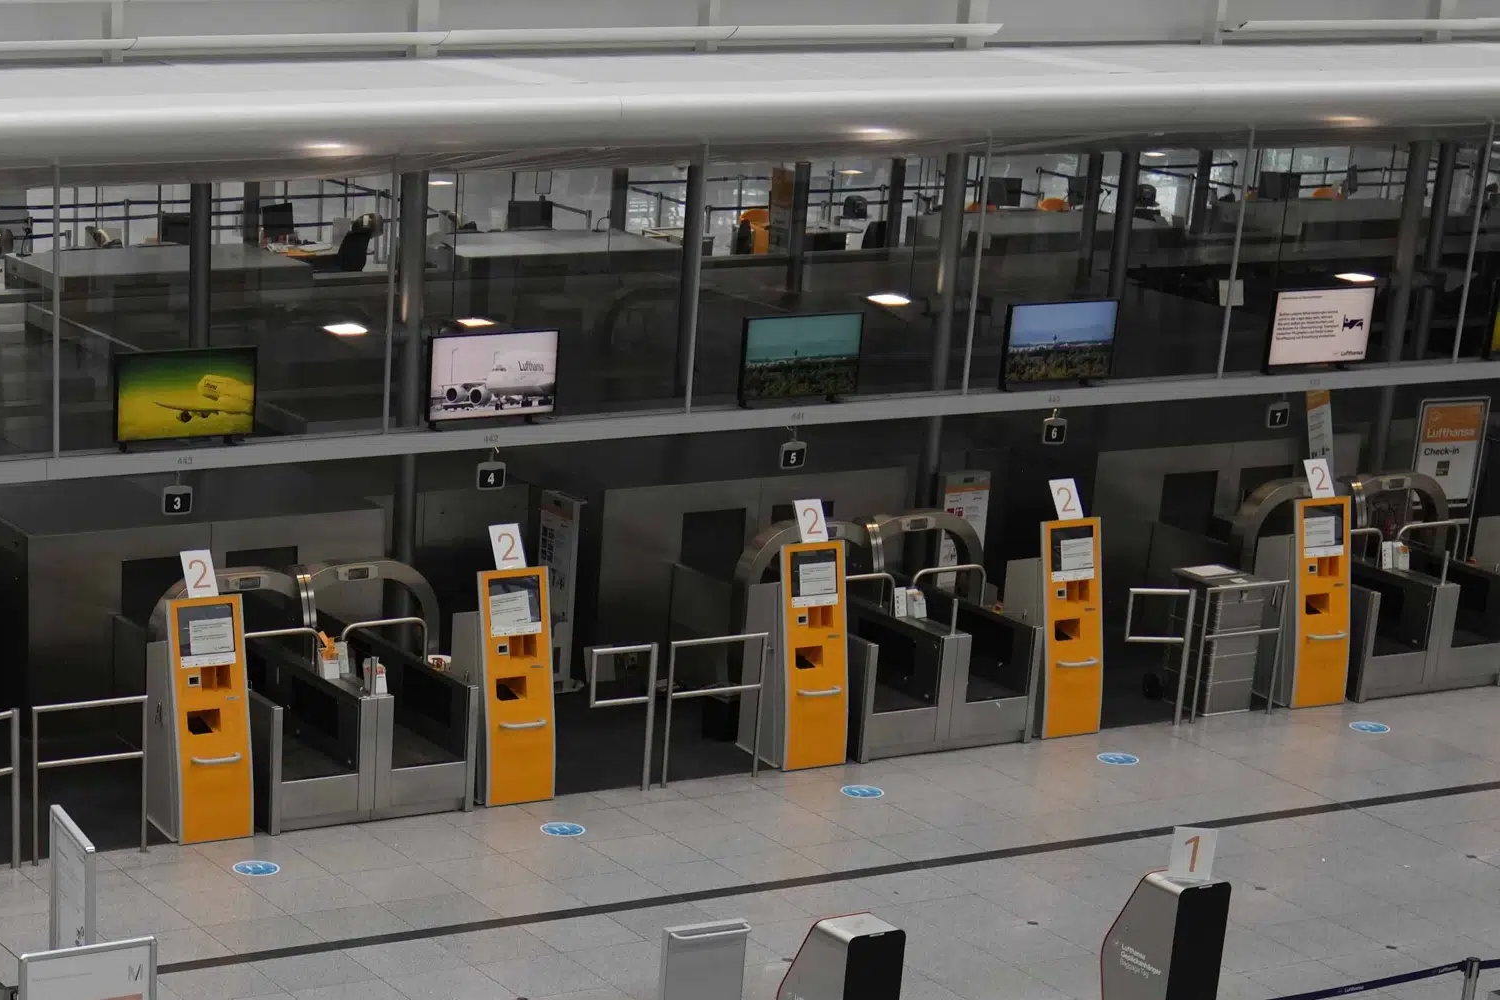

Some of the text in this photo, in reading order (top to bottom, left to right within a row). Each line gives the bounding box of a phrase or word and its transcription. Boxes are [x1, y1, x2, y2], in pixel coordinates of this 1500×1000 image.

[1340, 349, 1364, 357] Lufthansa
[518, 360, 545, 372] Lufthansa
[1275, 412, 1282, 424] 7
[483, 434, 499, 444] 442
[1051, 427, 1058, 440] 6
[1426, 427, 1476, 438] Lufthansa
[1423, 446, 1460, 456] Check-in
[177, 456, 193, 465] 443
[789, 452, 797, 464] 5
[487, 472, 495, 485] 4
[1311, 466, 1329, 491] 2
[173, 496, 181, 510] 3
[1057, 486, 1076, 512] 2
[803, 507, 822, 535] 2
[497, 533, 519, 561] 2
[189, 559, 211, 589] 2
[1184, 835, 1200, 873] 1
[1121, 943, 1146, 960] Lufthansa
